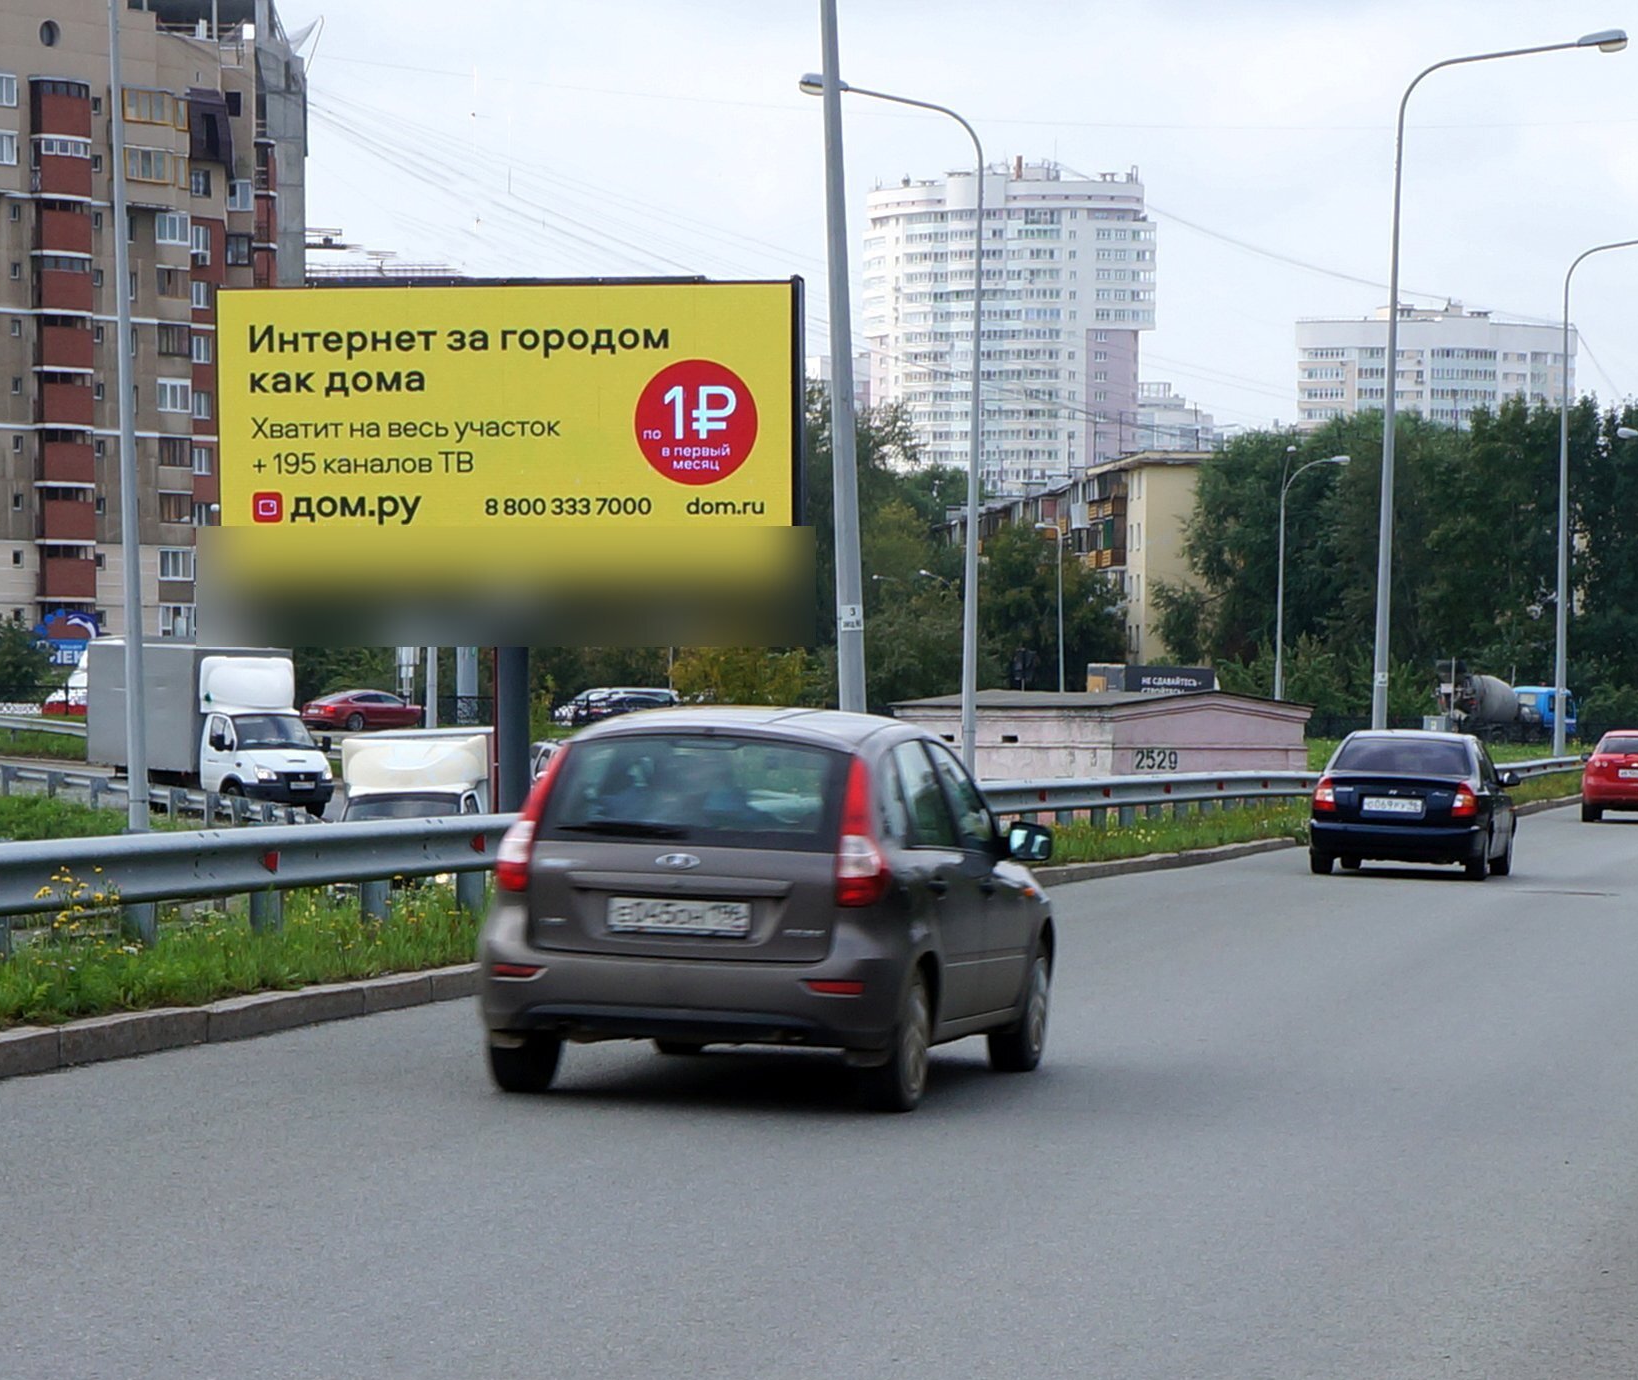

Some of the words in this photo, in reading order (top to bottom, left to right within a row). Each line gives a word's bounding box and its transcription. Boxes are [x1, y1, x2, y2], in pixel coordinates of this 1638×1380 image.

[249, 324, 437, 360] Интернет
[446, 329, 489, 351] за
[501, 328, 669, 358] городом
[249, 371, 315, 393] как
[324, 370, 425, 397] дома
[251, 417, 343, 439] Хватит
[350, 422, 380, 438] на
[388, 421, 449, 438] весь
[454, 420, 560, 443] участок
[643, 429, 662, 440] по
[661, 446, 670, 457] в
[673, 443, 731, 459] первый
[252, 459, 267, 474] +
[273, 452, 316, 475] 195
[324, 458, 433, 474] каналов
[438, 451, 474, 473] ТВ
[672, 460, 720, 471] месяц
[290, 496, 422, 525] дом.ру
[485, 498, 498, 515] 8
[503, 498, 546, 515] 800
[551, 498, 591, 515] 333
[595, 498, 652, 515] 7000
[686, 497, 765, 515] dom.ru
[1141, 677, 1151, 685] НЕ
[1135, 750, 1178, 770] 2529
